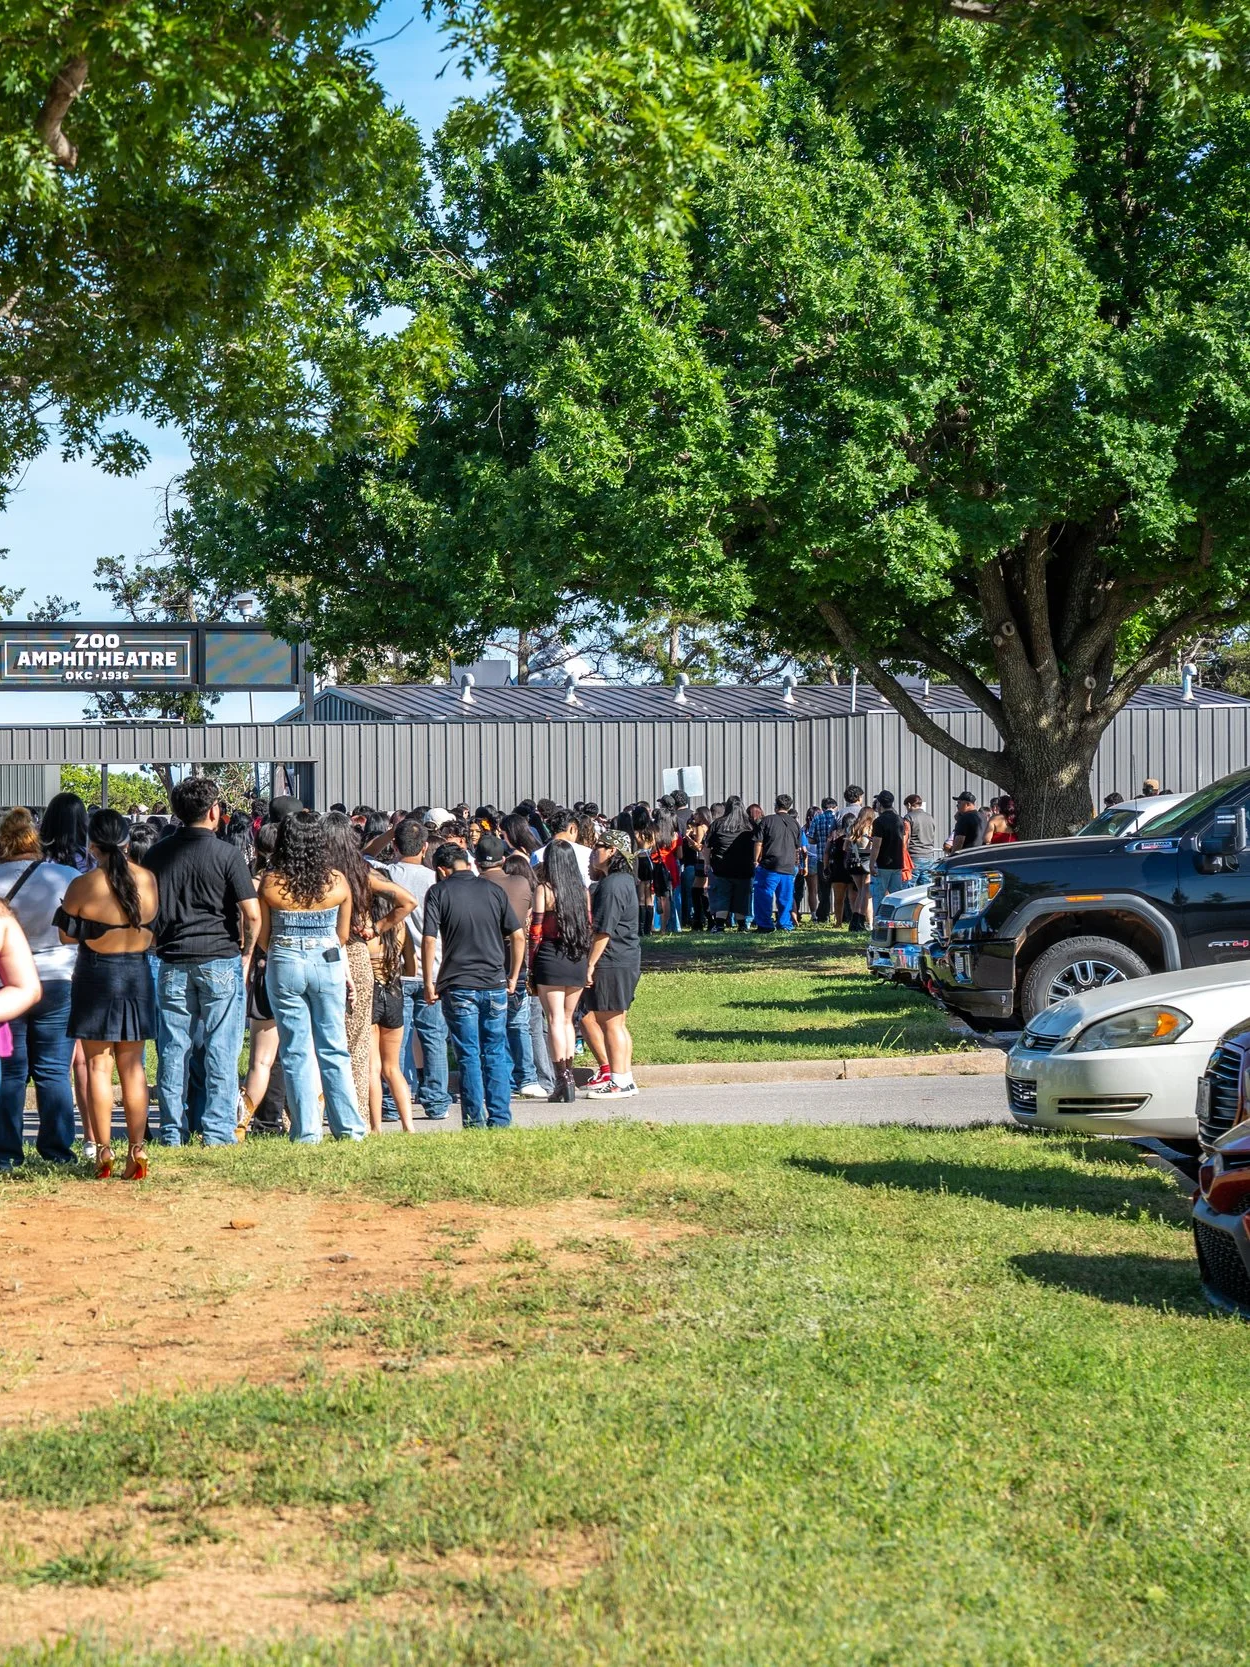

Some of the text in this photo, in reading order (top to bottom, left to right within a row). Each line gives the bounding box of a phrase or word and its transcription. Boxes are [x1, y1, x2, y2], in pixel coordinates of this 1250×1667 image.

[74, 633, 120, 649] ZOO
[17, 651, 177, 667] AMPHITHEATRE
[65, 671, 129, 680] OKC 1936
